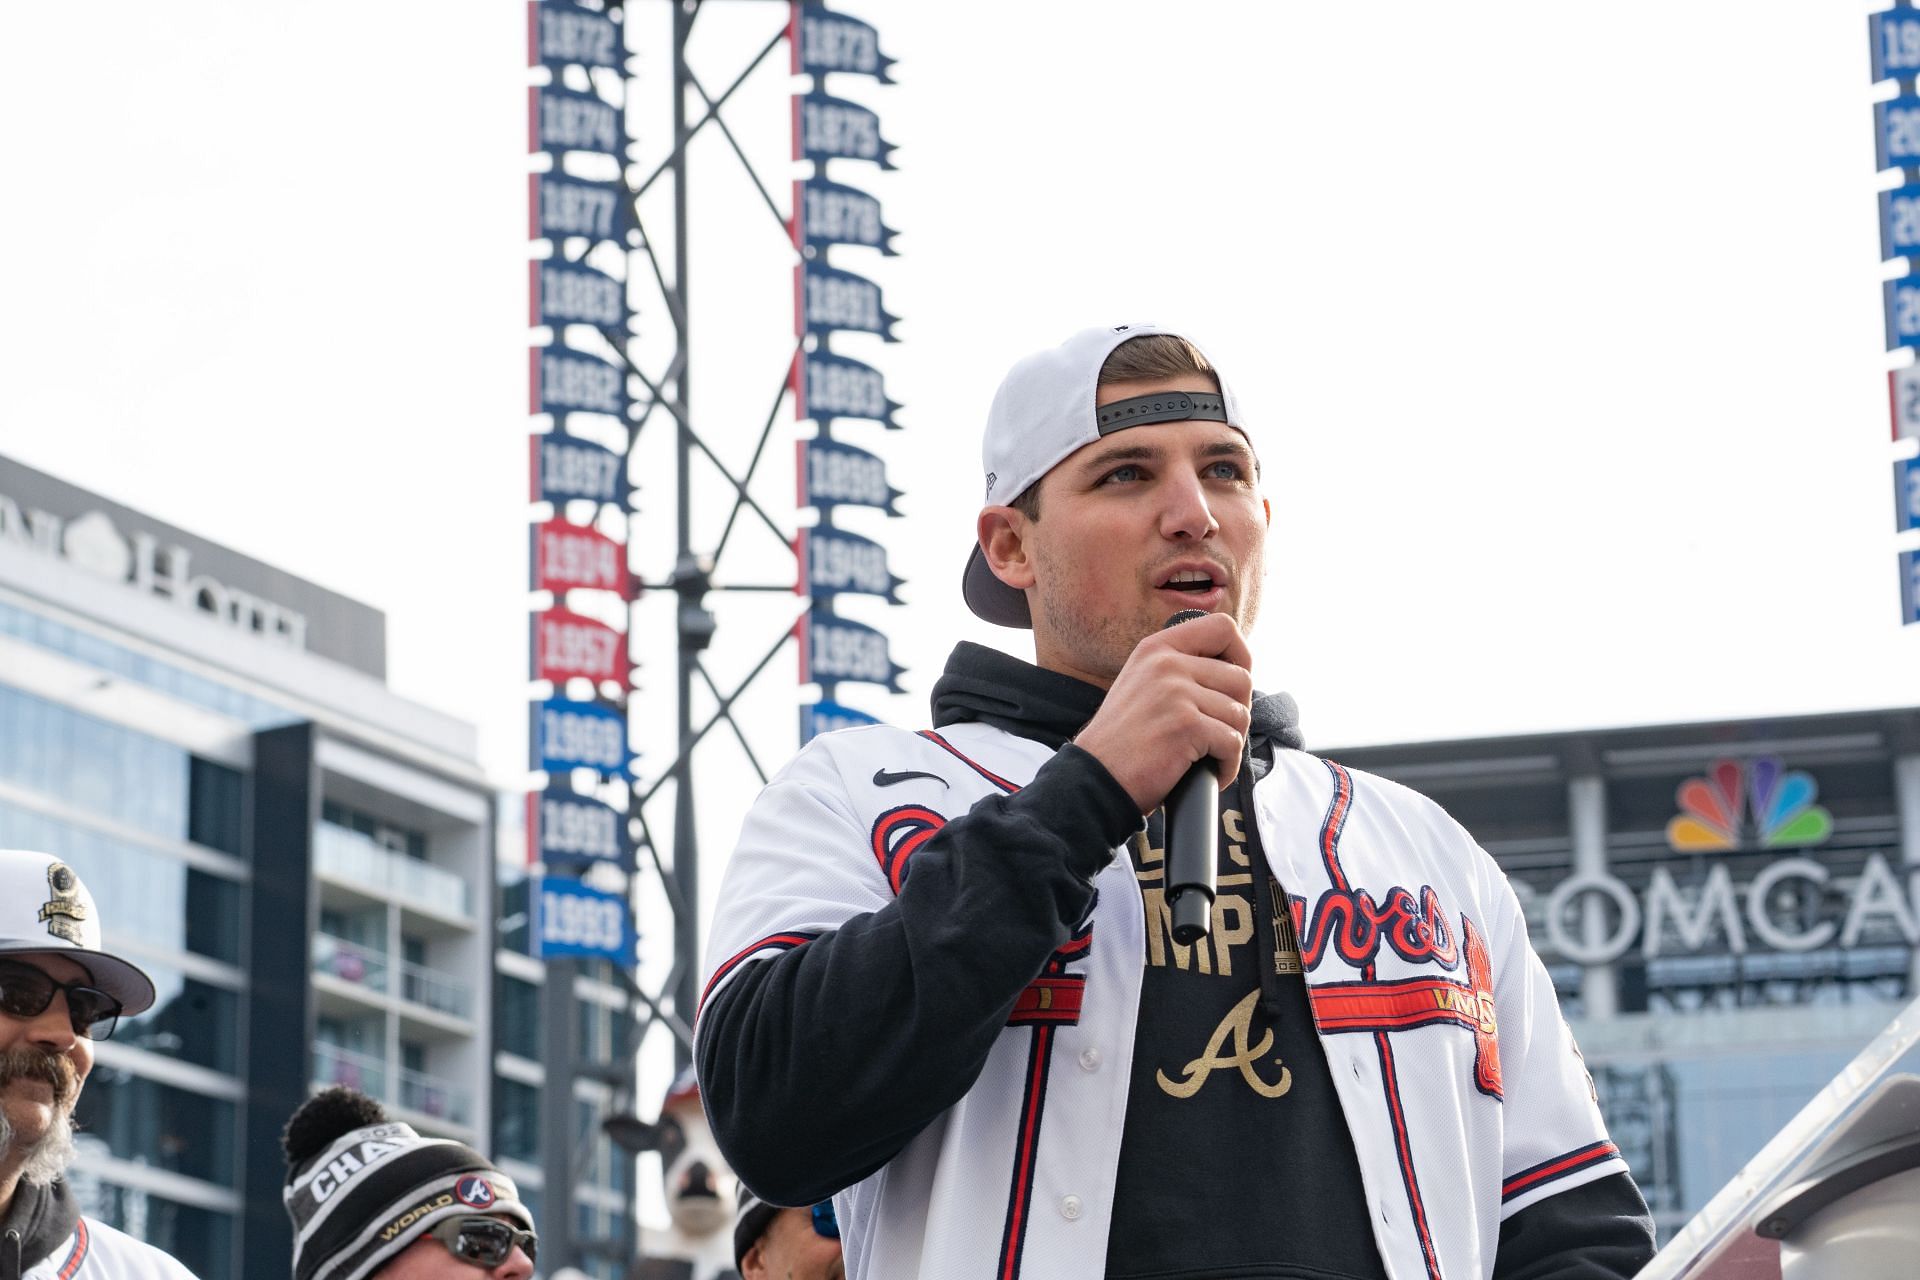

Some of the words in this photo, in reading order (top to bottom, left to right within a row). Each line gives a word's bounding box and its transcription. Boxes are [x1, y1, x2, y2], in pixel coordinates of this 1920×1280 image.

[1885, 18, 1920, 69] 19
[1887, 106, 1920, 156] 20
[1510, 852, 1920, 964] OMCA
[380, 1193, 454, 1242] WORLD
